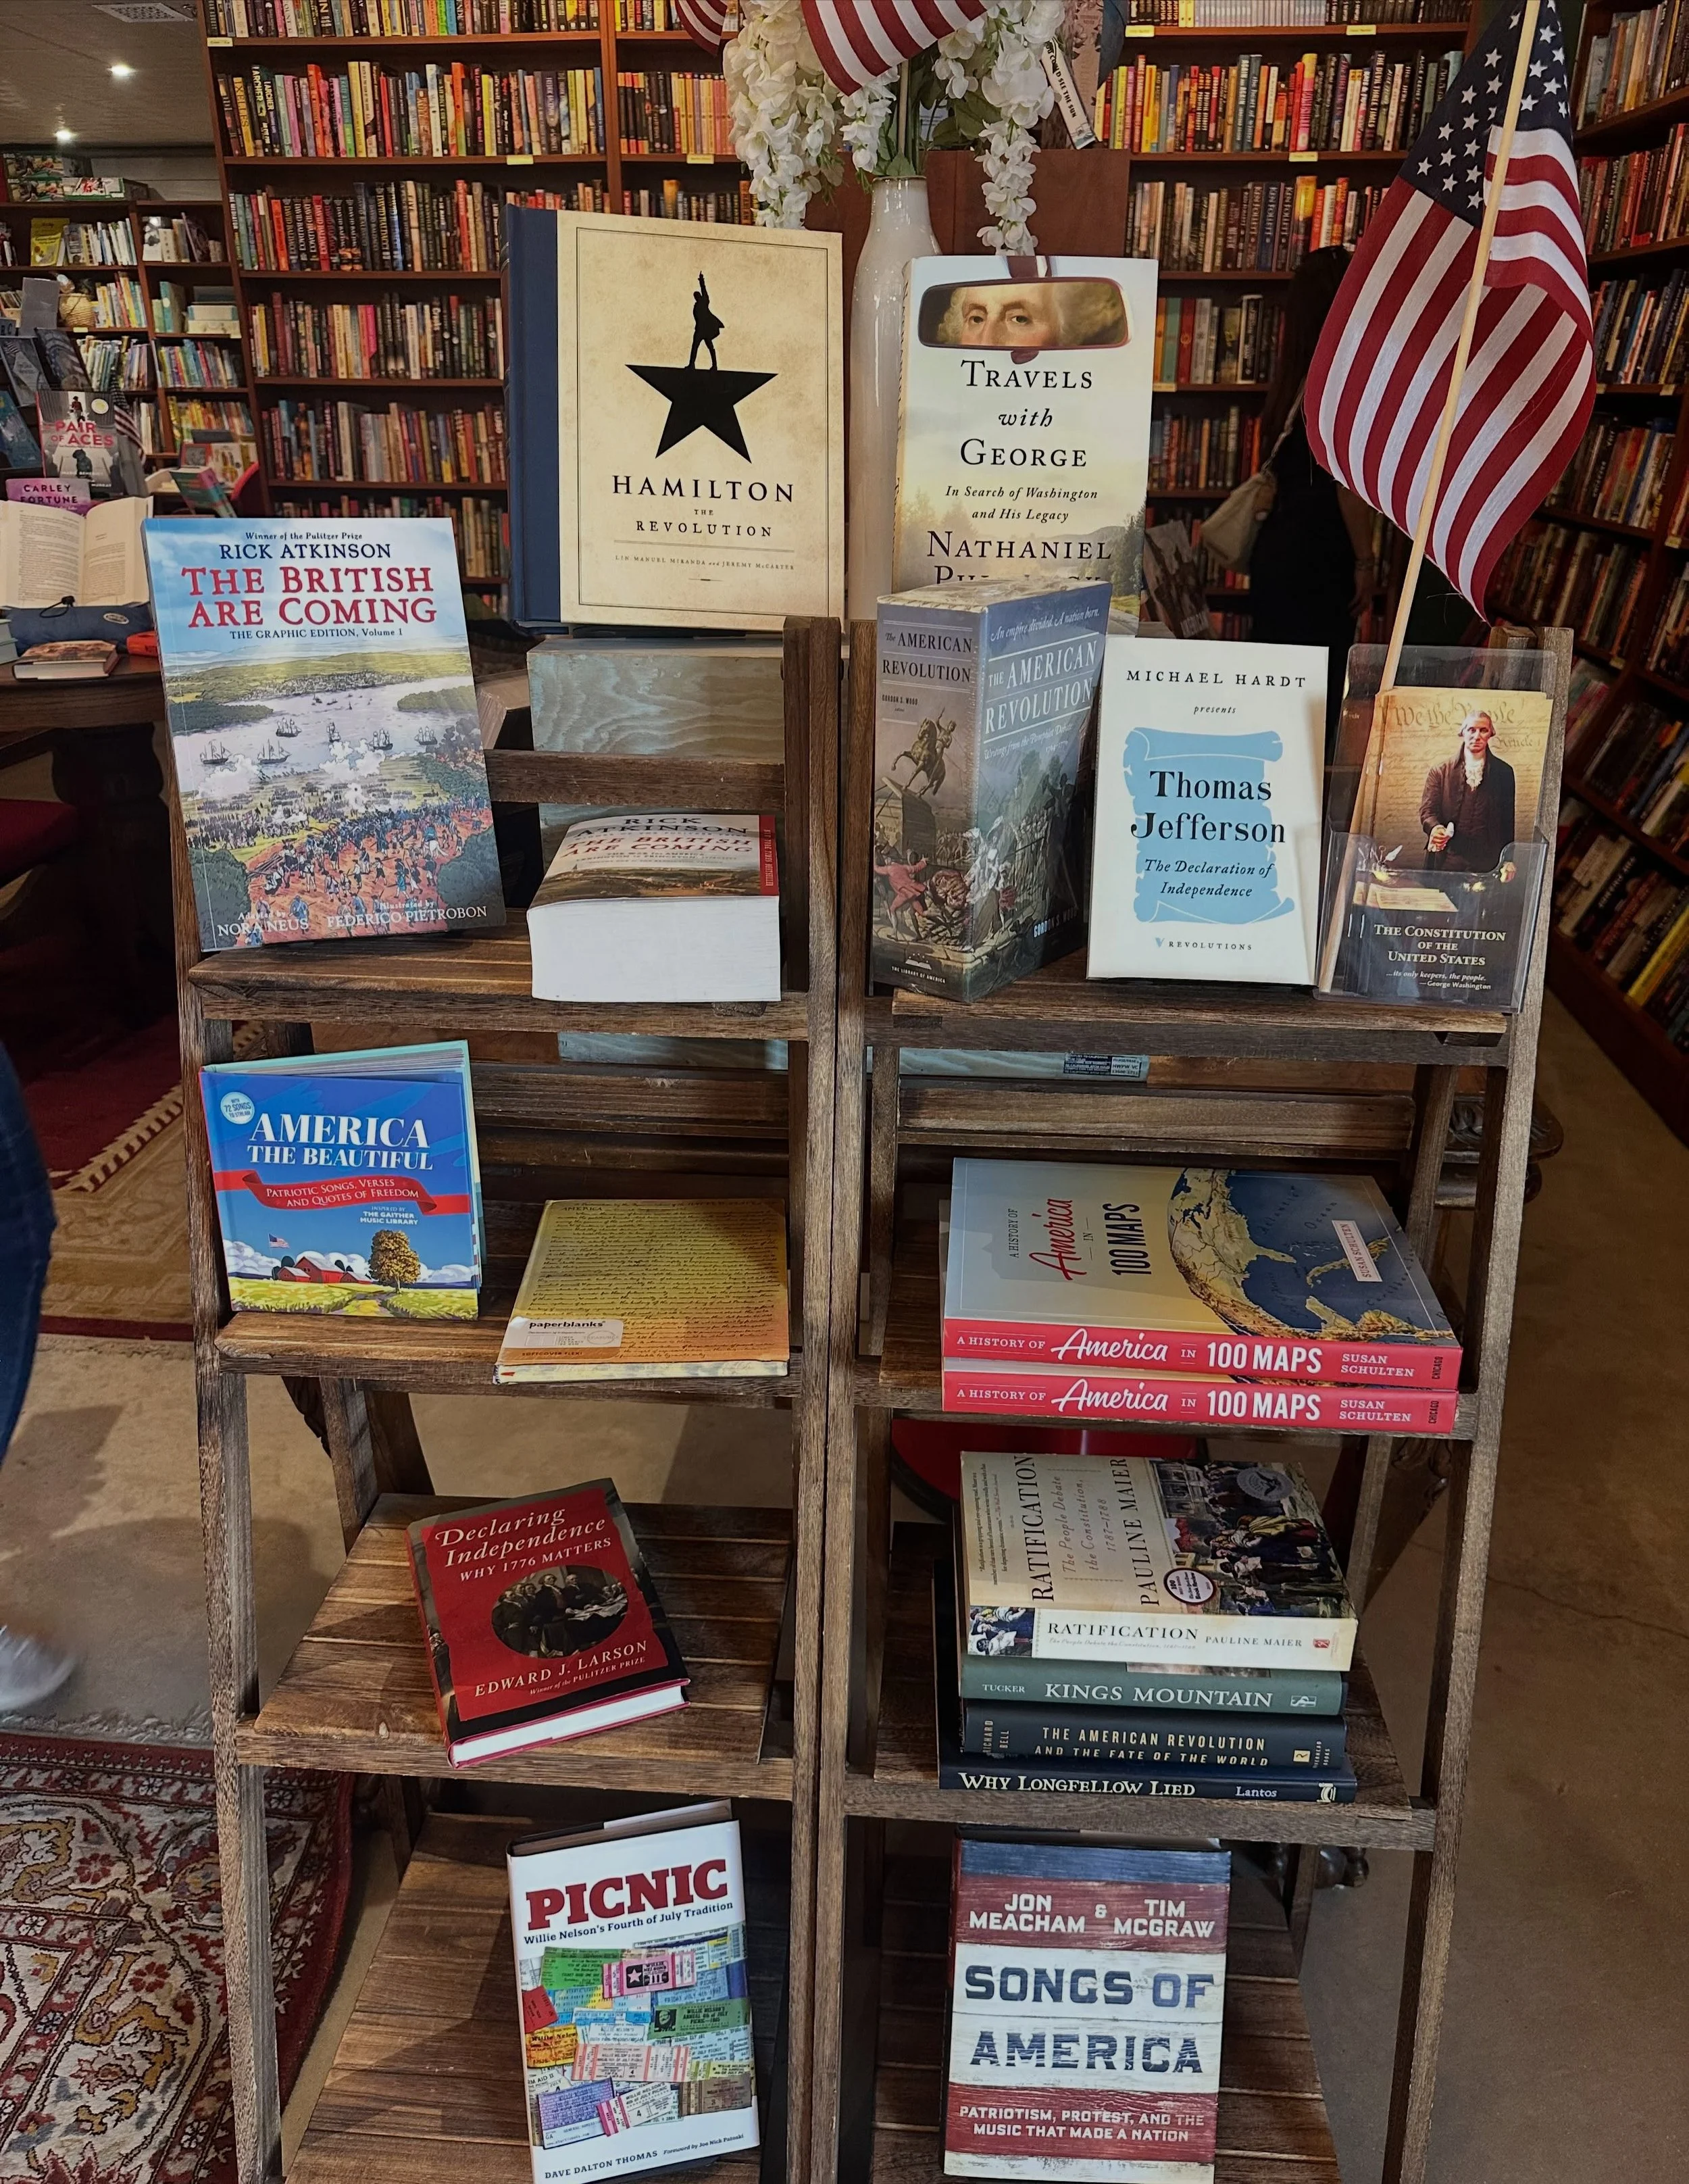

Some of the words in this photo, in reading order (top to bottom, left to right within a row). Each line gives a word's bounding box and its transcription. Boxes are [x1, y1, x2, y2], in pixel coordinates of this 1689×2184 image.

[1058, 78, 1067, 90] SEE
[1063, 90, 1072, 104] THE
[1068, 104, 1077, 118] SUN
[961, 359, 1092, 389] TRAVELS
[55, 421, 97, 433] PAIR
[998, 408, 1053, 427] with
[68, 433, 114, 447] ACES
[960, 438, 1087, 467] GEORGE
[20, 495, 78, 504] FORTUNE
[24, 484, 71, 493] CARLEY
[612, 475, 793, 502] HAMILTON
[946, 486, 959, 497] In
[964, 486, 1004, 498] Search
[1009, 487, 1024, 502] of
[1026, 487, 1098, 503] Washington
[636, 520, 772, 537] REVOLUTION
[972, 508, 995, 520] and
[999, 508, 1021, 520] His
[1026, 509, 1069, 524] Legacy
[219, 544, 273, 560] RICK
[280, 543, 390, 559] ATKINSON
[927, 530, 1112, 560] NATHANIEL
[181, 567, 265, 595] THE
[280, 566, 434, 593] BRITISH
[188, 600, 263, 628] ARE
[279, 597, 437, 625] COMING
[230, 630, 253, 639] THE
[255, 629, 307, 639] GRAPHIC
[310, 628, 359, 638] EDITION,
[362, 628, 395, 637] Volume
[399, 628, 403, 636] 1
[885, 632, 896, 642] The
[898, 632, 973, 653] AMERICAN
[882, 659, 971, 682] REVOLUTION
[988, 671, 1005, 687] THE
[1007, 641, 1097, 689] AMERICAN
[1126, 670, 1223, 685] MICHAEL
[1236, 675, 1306, 688] HARDT
[985, 677, 1093, 735] REVOLUTION
[1194, 705, 1236, 715] presents
[1149, 770, 1271, 801] Thomas
[576, 825, 749, 837] ATKINSON
[1130, 812, 1286, 843] Jefferson
[1144, 860, 1171, 872] The
[1175, 861, 1255, 876] Declaration
[1259, 864, 1276, 878] of
[1160, 882, 1253, 899] Independence
[326, 910, 403, 928] FEDERICO
[405, 905, 488, 924] PIETROBON
[1374, 924, 1402, 936] THE
[1405, 925, 1507, 941] CONSTITUTION
[1169, 941, 1253, 950] REVOLUTIONS
[1417, 941, 1432, 949] OF
[1435, 942, 1458, 951] THE
[1388, 951, 1437, 964] UNITED
[1440, 953, 1486, 966] STATES
[901, 967, 919, 976] LIBRARY
[926, 974, 946, 984] AMERICA
[232, 1102, 251, 1111] SONGS
[249, 1113, 430, 1148] AMERICA
[247, 1145, 296, 1164] THE
[303, 1147, 434, 1170] BEAUTIFUL
[1102, 1203, 1146, 1246] MAPS
[1029, 1199, 1087, 1281] America
[1340, 1223, 1363, 1256] SCHULTEN
[1109, 1249, 1152, 1275] 100
[1354, 1257, 1372, 1278] SUSAN
[957, 1337, 965, 1345] A
[969, 1337, 1026, 1349] HISTORY
[1028, 1340, 1046, 1349] OF
[1051, 1328, 1168, 1362] America
[1181, 1349, 1196, 1358] IN
[1207, 1342, 1248, 1369] 100
[1253, 1344, 1323, 1374] MAPS
[1342, 1354, 1388, 1364] SUSAN
[1340, 1364, 1415, 1377] SCHULTEN
[1432, 1356, 1443, 1380] CHICAGO
[1110, 1458, 1138, 1512] MAIER
[435, 1508, 566, 1547] Declaring
[1014, 1455, 1054, 1602] RATIFICATION
[445, 1518, 605, 1568] Independence
[460, 1566, 495, 1582] WHY
[502, 1557, 536, 1572] 1776
[541, 1537, 612, 1564] MATTERS
[1124, 1519, 1160, 1606] PAULINE
[1048, 1622, 1199, 1640] RATIFICATION
[1205, 1636, 1259, 1646] PAULINE
[1263, 1637, 1303, 1647] MAIER
[474, 1668, 551, 1697] EDWARD
[558, 1663, 571, 1676] J.
[578, 1641, 648, 1670] LARSON
[530, 1683, 553, 1695] Winner
[572, 1665, 617, 1683] PULITZER
[619, 1657, 645, 1669] PRIZE
[982, 1683, 1025, 1693] TUCKER
[1044, 1683, 1124, 1701] KINGS
[1134, 1687, 1274, 1708] MOUNTAIN
[999, 1731, 1009, 1748] BELL
[1042, 1727, 1070, 1740] THE
[1079, 1729, 1159, 1746] AMERICAN
[1167, 1734, 1265, 1752] REVOLUTION
[957, 1772, 1011, 1790] WHY
[1017, 1775, 1144, 1794] LONGFELLOW
[1149, 1781, 1196, 1795] LIED
[1236, 1785, 1278, 1798] Lantos
[526, 1859, 728, 1931] PICNIC
[1005, 1893, 1052, 1912] JON
[1095, 1904, 1107, 1918] &
[1144, 1899, 1186, 1918] TIM
[524, 1933, 557, 1945] Willie
[559, 1925, 605, 1940] Nelson's
[607, 1918, 643, 1931] Fourth
[646, 1914, 657, 1925] of
[659, 1911, 682, 1924] July
[684, 1902, 734, 1918] Tradition
[969, 1911, 1085, 1934] MEACHAM
[1113, 1918, 1215, 1938] MCGRAW
[965, 1965, 1133, 2005] SONGS
[1152, 1972, 1215, 2008] OF
[969, 2031, 1203, 2073] AMERICA
[959, 2106, 1057, 2123] PATRIOTISM,
[1061, 2109, 1134, 2125] PROTEST,
[1138, 2113, 1171, 2126] AND
[1175, 2114, 1205, 2127] THE
[663, 2144, 690, 2156] Foreword
[691, 2143, 698, 2151] by
[723, 2133, 744, 2143] Patoski
[974, 2123, 1022, 2137] MUSIC
[1026, 2125, 1066, 2138] THAT
[1069, 2127, 1113, 2139] MADE
[1116, 2129, 1127, 2139] A
[1132, 2129, 1189, 2142] NATION
[545, 2168, 572, 2179] DAVE
[574, 2159, 613, 2175] DALTON
[615, 2150, 657, 2165] THOMAS
